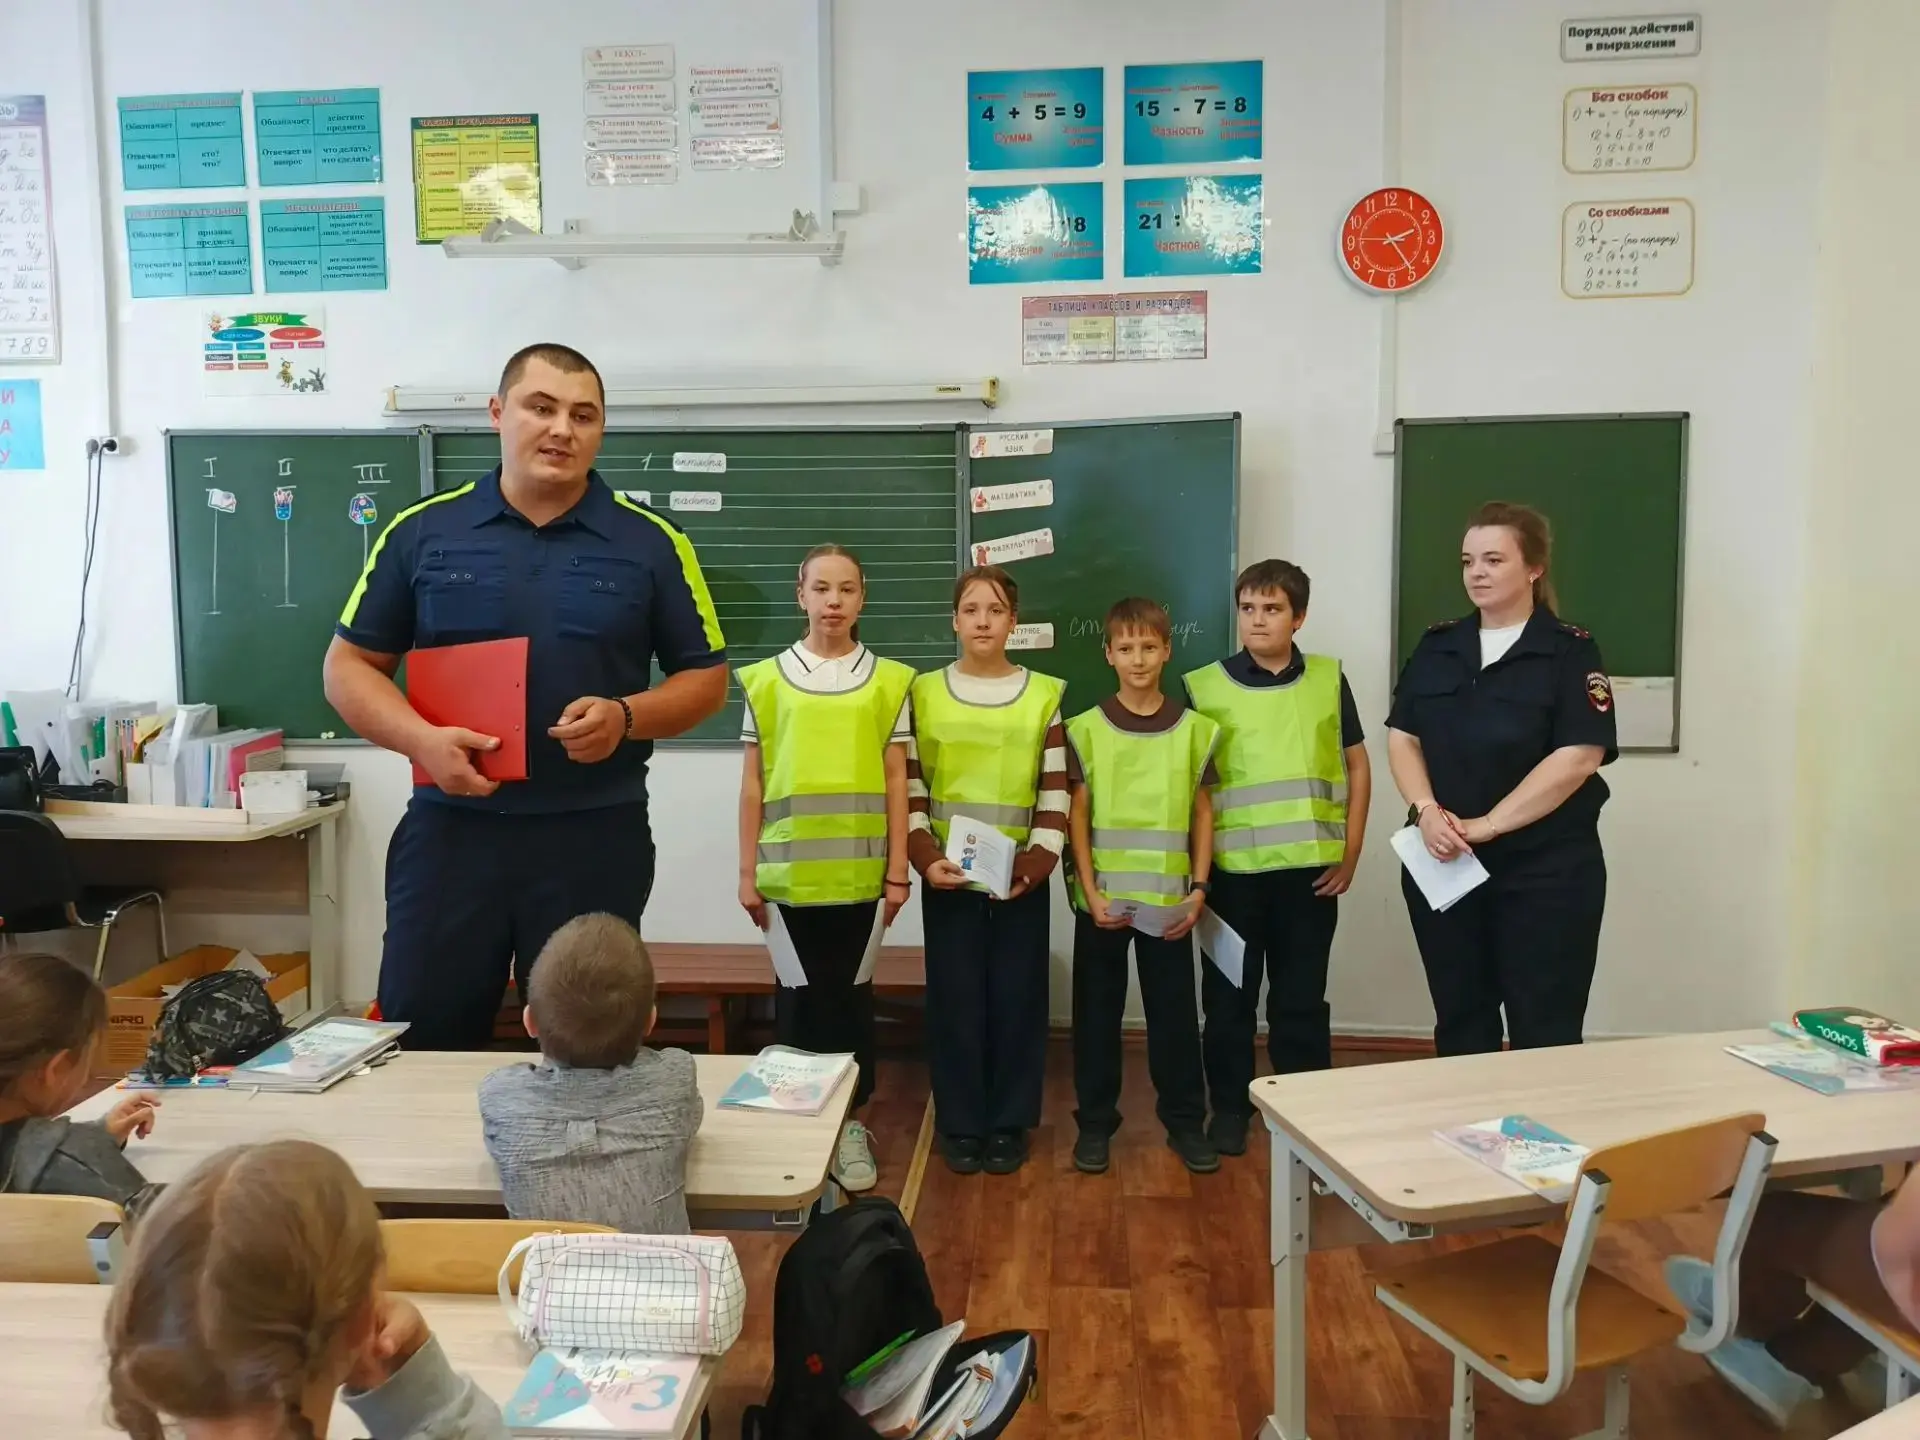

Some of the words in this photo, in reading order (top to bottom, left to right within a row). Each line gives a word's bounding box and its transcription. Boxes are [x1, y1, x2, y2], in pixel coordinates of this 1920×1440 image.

[1568, 25, 1627, 39] Порядок
[1629, 20, 1694, 36] действий
[1586, 43, 1593, 51] в
[1596, 38, 1676, 52] выражении
[1592, 92, 1615, 103] Без
[1618, 88, 1668, 102] скобок
[982, 106, 995, 121] 4
[1035, 105, 1046, 120] 5
[1074, 103, 1086, 119] 9
[1135, 100, 1160, 117] 15
[1194, 98, 1206, 114] 7
[1234, 97, 1246, 112] 8
[126, 122, 173, 130] Обозначает
[261, 117, 310, 126] Обозначает
[994, 132, 1032, 144] Сумма
[1152, 126, 1204, 136] Разность
[201, 150, 220, 158] кто?
[262, 148, 300, 156] Отвечает
[339, 145, 372, 153] делать?
[1365, 198, 1375, 212] 11
[1384, 191, 1398, 207] 12
[1408, 196, 1413, 210] 1
[1421, 209, 1430, 224] 2
[1588, 207, 1603, 217] Со
[1606, 206, 1669, 217] скобками
[1139, 213, 1162, 229] 21
[1350, 215, 1362, 230] 10
[267, 225, 315, 233] Обозначает
[1347, 235, 1355, 251] 9
[1427, 230, 1435, 245] 3
[1155, 242, 1201, 252] Частное
[217, 257, 247, 266] какой?
[269, 258, 307, 266] Отвечает
[1353, 255, 1360, 270] 8
[1422, 250, 1430, 265] 4
[279, 269, 308, 277] вопрос
[1367, 269, 1375, 284] 7
[1408, 266, 1416, 281] 5
[1387, 273, 1396, 288] 6
[1049, 301, 1088, 312] ТАБЛИЦА
[1092, 299, 1131, 311] КЛАССОВ
[1136, 301, 1141, 309] И
[1146, 298, 1192, 310] РАЗРЯДОВ
[253, 314, 283, 323] ЗВУКИ
[8, 338, 16, 351] 7
[21, 336, 31, 354] 8
[38, 336, 48, 354] 9
[2, 389, 15, 404] И
[0, 419, 11, 433] А
[1000, 432, 1029, 441] РУССКИЙ
[0, 449, 10, 463] У
[1005, 445, 1024, 453] ЯЗЫК
[641, 452, 653, 471] 1
[352, 463, 391, 483] III
[990, 490, 1036, 501] МАТЕМАТИКА
[991, 538, 1039, 553] ФИЗКУЛЬТУРА
[1816, 1024, 1859, 1051] SCHOOL
[631, 1374, 681, 1411] 3
